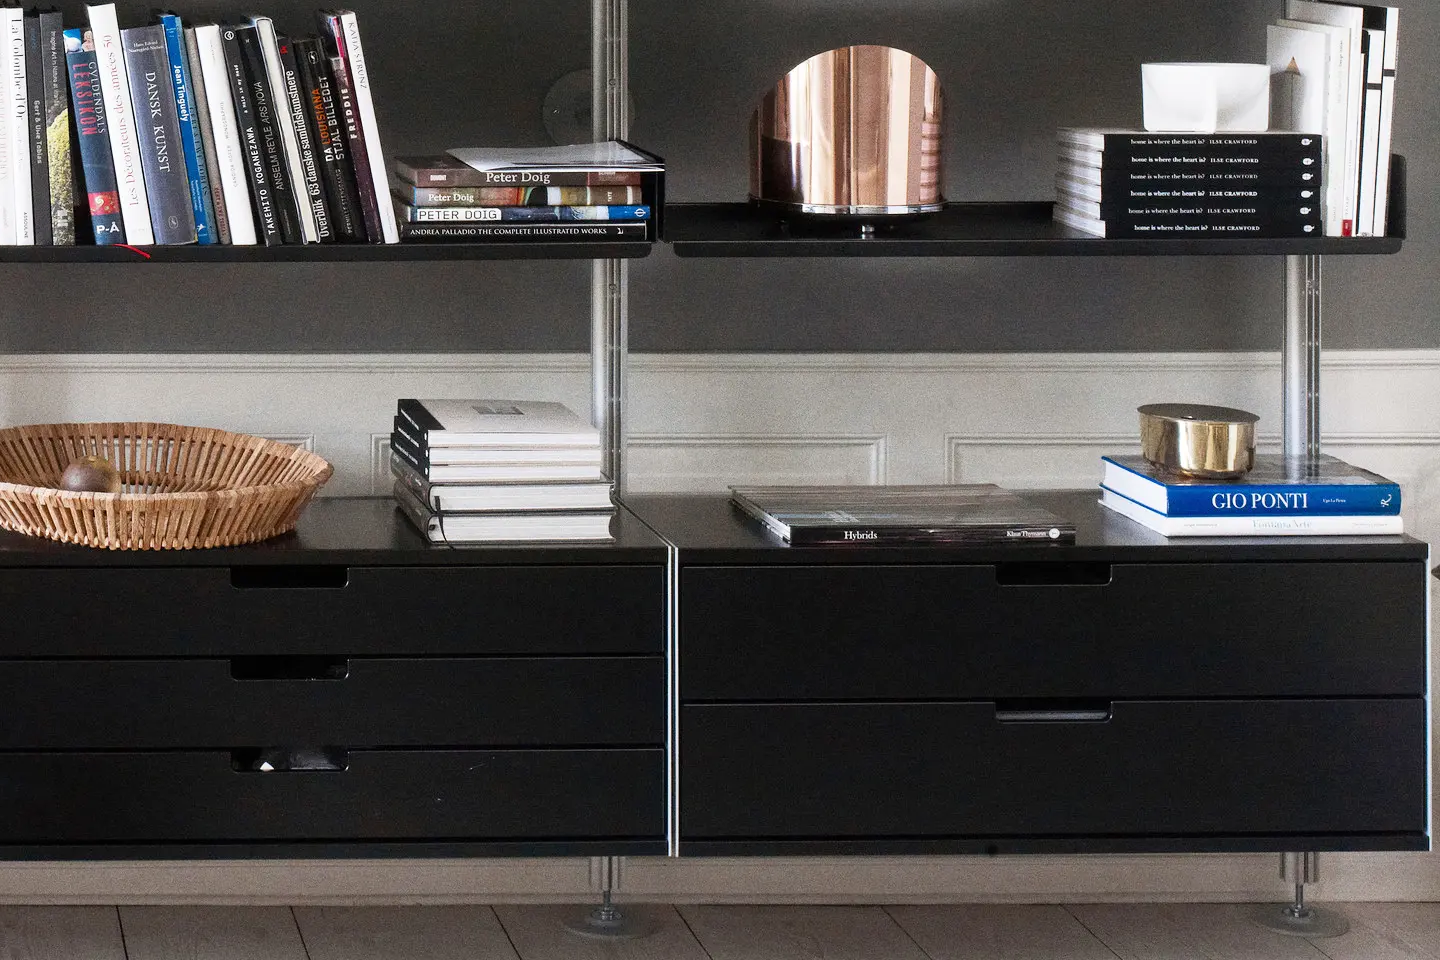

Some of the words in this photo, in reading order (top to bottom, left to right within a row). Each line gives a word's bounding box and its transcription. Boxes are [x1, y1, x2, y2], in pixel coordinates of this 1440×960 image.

[173, 64, 185, 85] Jean
[72, 63, 97, 136] LEKSIKON
[88, 61, 106, 134] GYLDENDALS
[145, 72, 162, 119] DANSK
[176, 85, 190, 122] Tinguely
[153, 125, 171, 173] KUNST
[486, 172, 517, 183] Peter
[522, 172, 551, 185] Doig
[420, 210, 459, 220] PETER
[465, 210, 497, 219] DOIG
[96, 222, 120, 234] P-Å
[1212, 493, 1247, 509] GIO
[1251, 493, 1308, 509] PONTI
[844, 531, 878, 540] Hybrids
